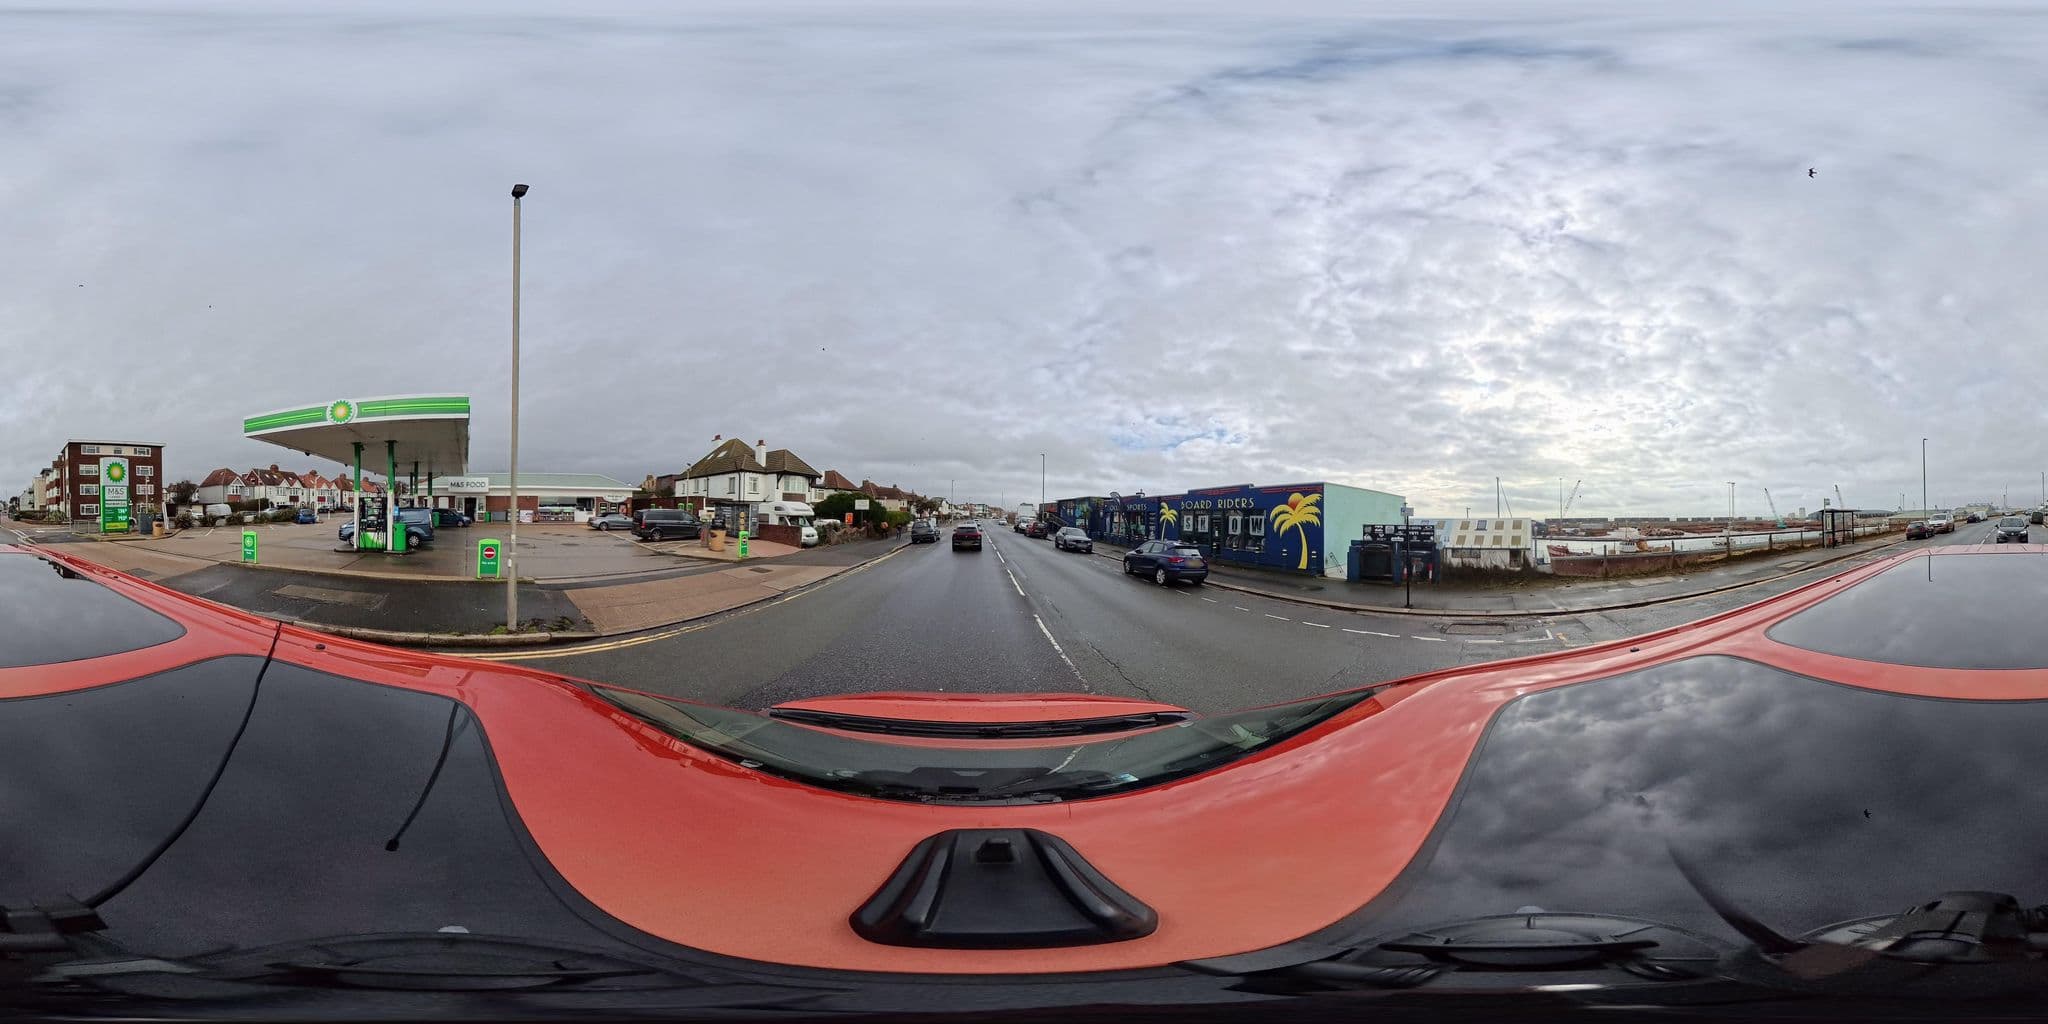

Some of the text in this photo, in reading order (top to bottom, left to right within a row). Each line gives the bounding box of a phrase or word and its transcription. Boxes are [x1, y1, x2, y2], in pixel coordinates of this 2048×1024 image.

[107, 487, 125, 495] M&S
[1126, 503, 1147, 512] SPORTS
[1181, 497, 1255, 510] BOARD RIDERS
